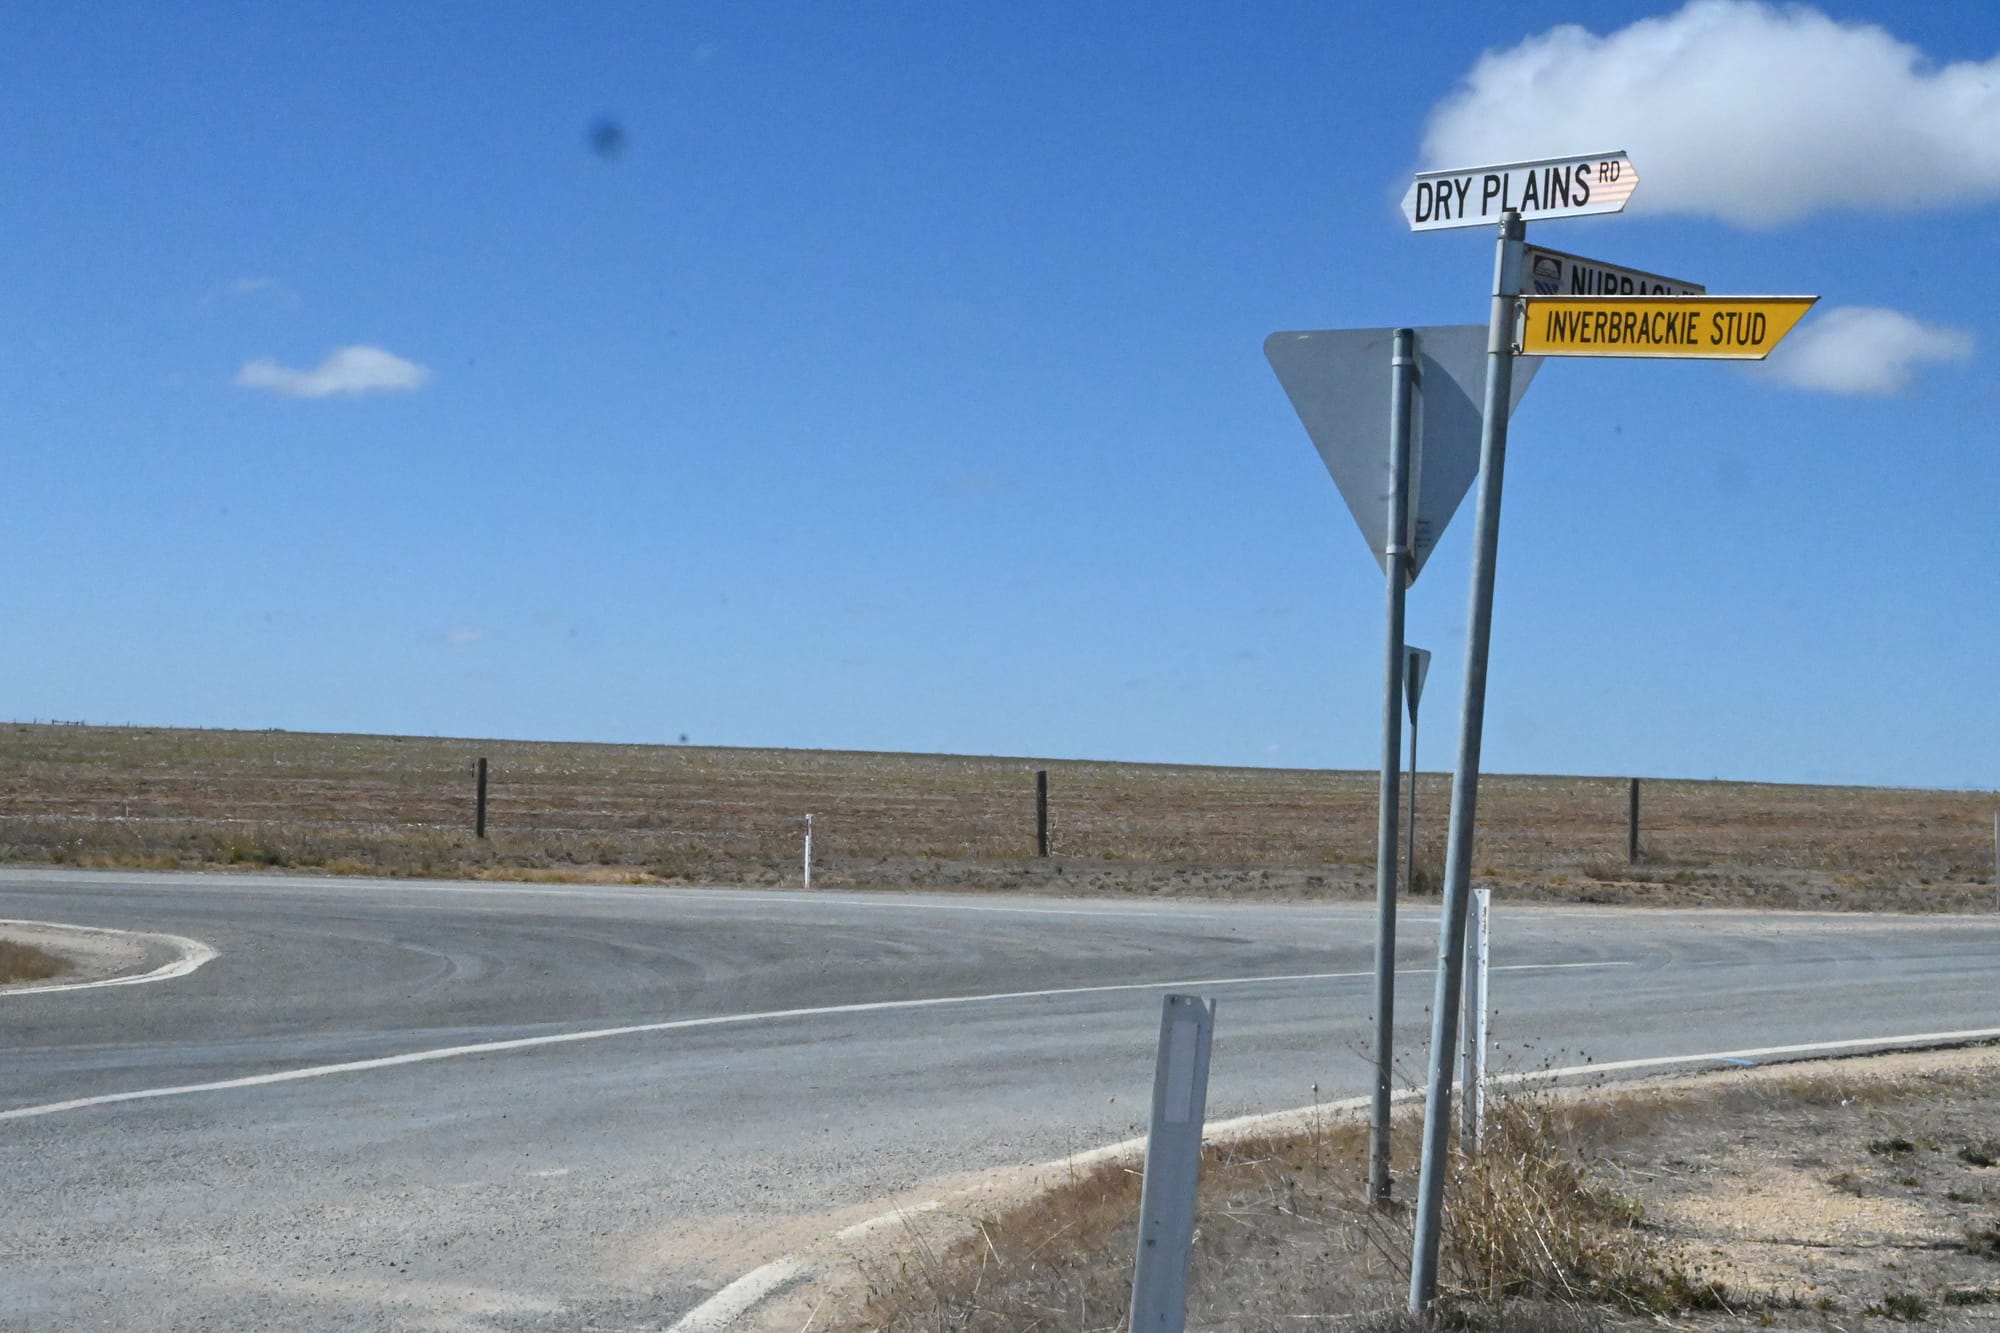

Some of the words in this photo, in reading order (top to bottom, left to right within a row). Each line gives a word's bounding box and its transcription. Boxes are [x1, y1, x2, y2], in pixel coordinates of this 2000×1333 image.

[1415, 176, 1472, 223] DRY
[1481, 163, 1592, 216] PLAINS
[1599, 160, 1620, 183] RD
[1546, 310, 1701, 345] INVERBRACKIE
[1710, 311, 1767, 346] STUD
